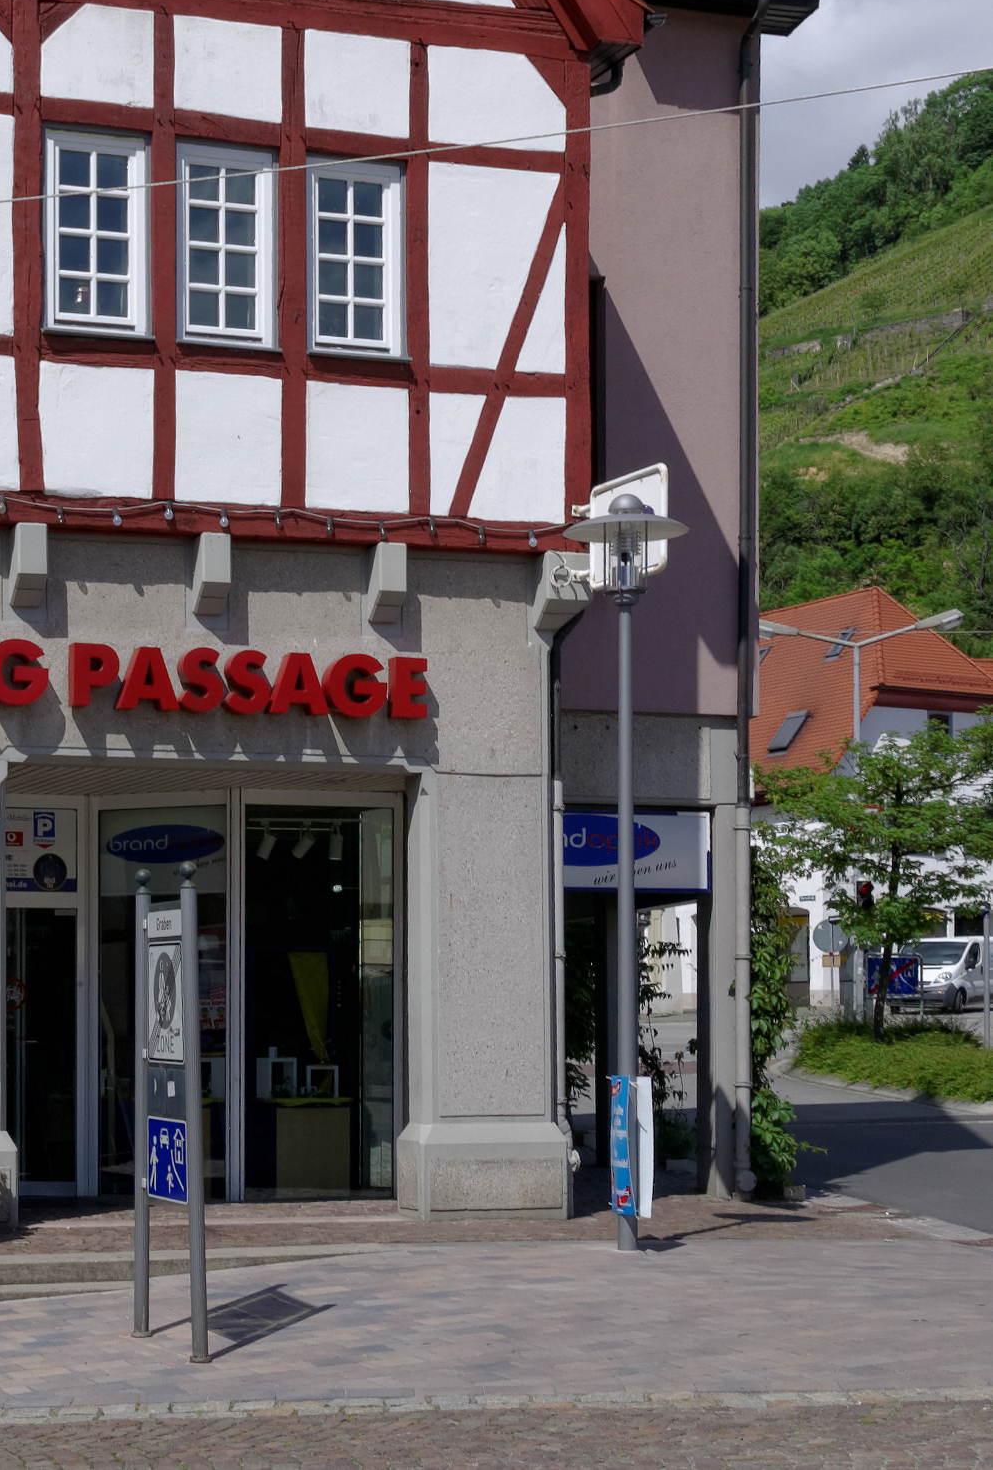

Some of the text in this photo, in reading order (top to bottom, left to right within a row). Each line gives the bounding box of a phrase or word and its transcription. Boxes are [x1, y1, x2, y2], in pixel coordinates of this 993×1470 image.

[69, 642, 428, 718] PASSAGE
[593, 870, 616, 885] wir
[655, 859, 677, 872] uns
[156, 917, 172, 931] Graben
[156, 1035, 175, 1054] ZONE
